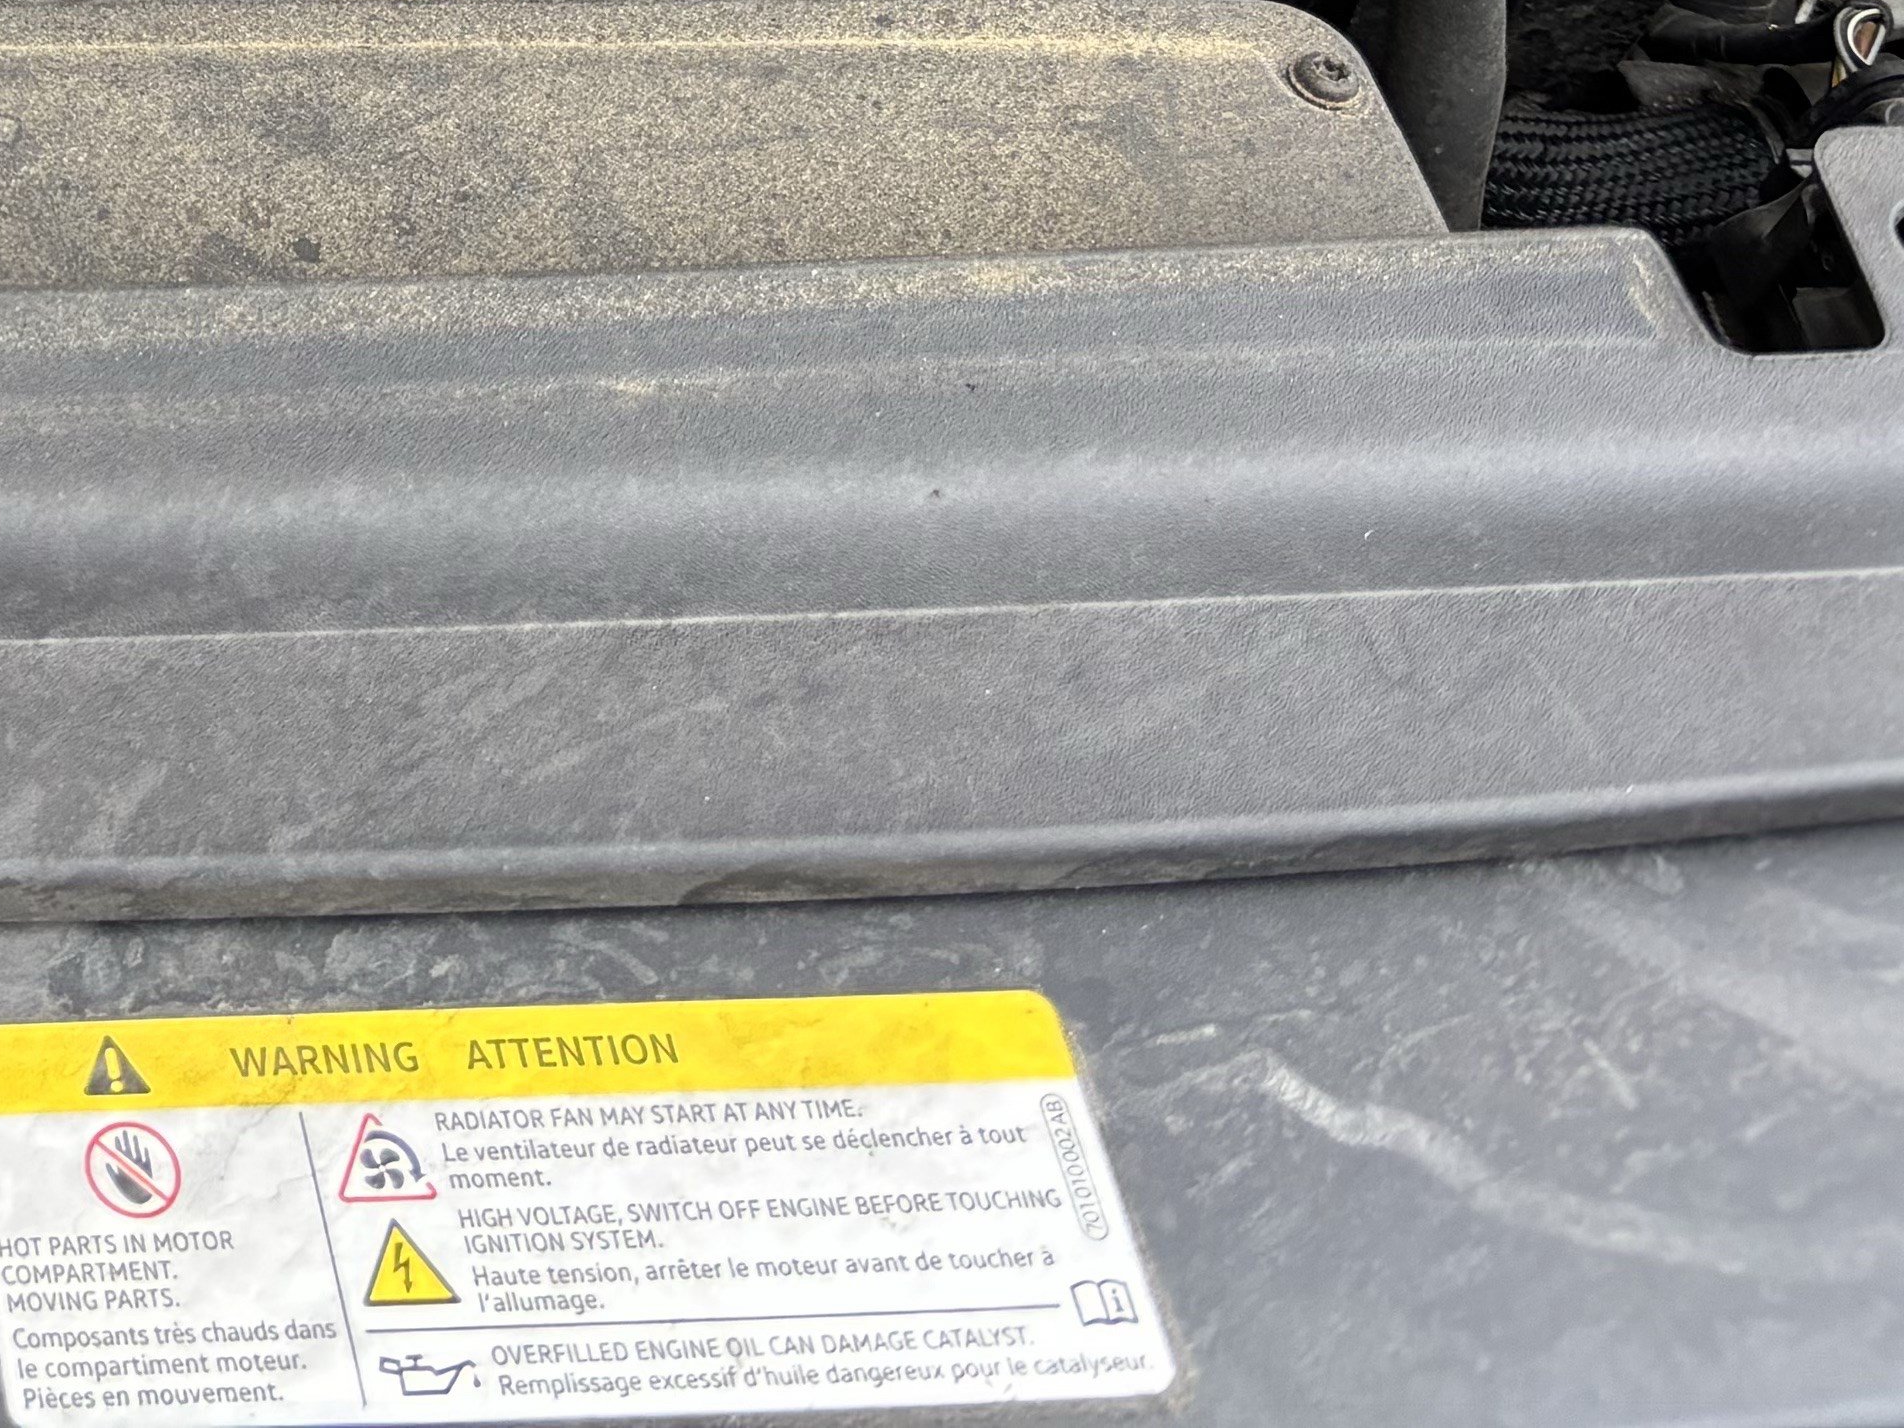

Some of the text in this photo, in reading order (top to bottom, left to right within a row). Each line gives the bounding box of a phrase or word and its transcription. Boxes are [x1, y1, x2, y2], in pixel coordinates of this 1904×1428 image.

[228, 1033, 679, 1082] WARNING ATTENTION
[434, 1098, 863, 1132] RADIATOR FAN MAY START AT ANY TIME.
[457, 1188, 1063, 1229] HIGH VOLTAGE, SWITCH OFF ENGINE BEFORE TOUCHING
[48, 1233, 117, 1256] PARTS
[123, 1233, 147, 1254] IN
[152, 1230, 235, 1253] MOTOR
[463, 1228, 664, 1255] IGNITION SYSTEM.
[0, 1259, 179, 1286] COMPARTMENT.
[6, 1287, 181, 1314] MOVING PARTS.
